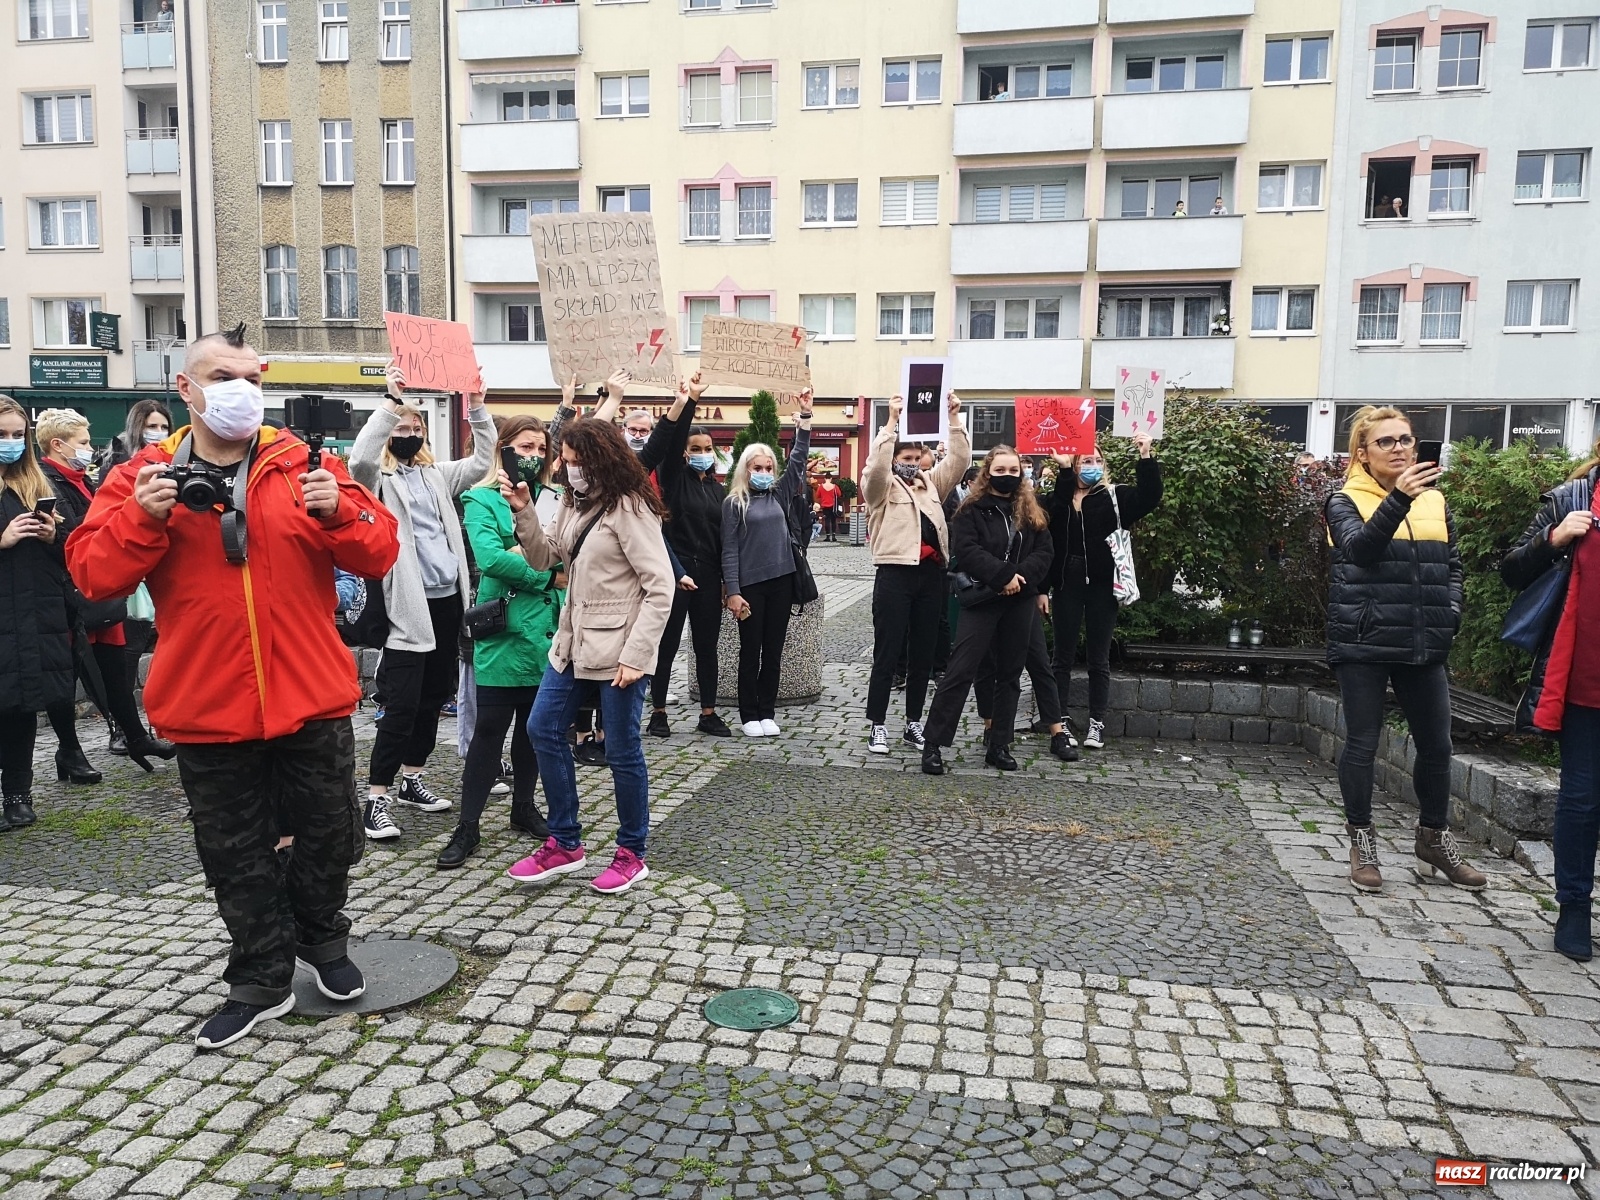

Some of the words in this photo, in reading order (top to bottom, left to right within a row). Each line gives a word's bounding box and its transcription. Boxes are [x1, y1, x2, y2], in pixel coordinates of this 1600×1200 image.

[541, 221, 650, 259] MEFEDRON
[546, 264, 578, 292] MA
[586, 261, 652, 287] LEPSZY
[554, 292, 617, 321] SKŁAD
[630, 288, 659, 312] NIŻ
[392, 319, 441, 354] MOJE
[564, 315, 649, 344] POLSKI
[712, 319, 763, 339] WALCZCIE
[773, 327, 785, 340] Z
[773, 342, 795, 358] NIE
[711, 356, 721, 371] Z
[727, 358, 799, 381] KOBIETAMI
[1024, 397, 1063, 409] CHCEMY
[1053, 408, 1059, 416] Z
[1060, 407, 1081, 416] TEGO
[1512, 424, 1561, 436] empik.com
